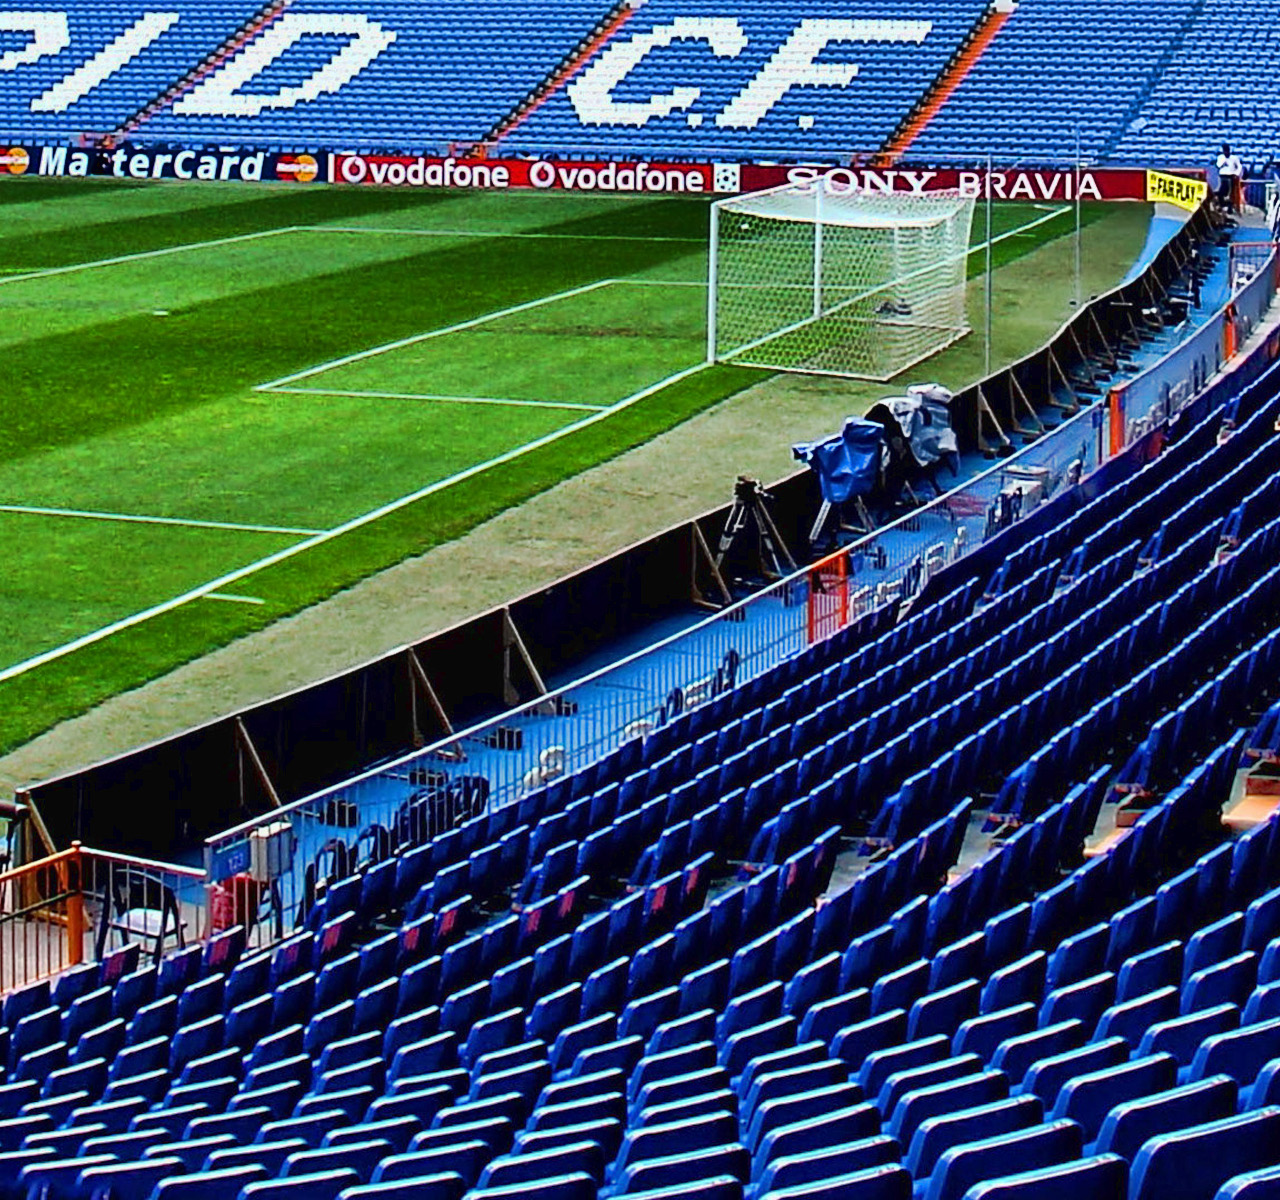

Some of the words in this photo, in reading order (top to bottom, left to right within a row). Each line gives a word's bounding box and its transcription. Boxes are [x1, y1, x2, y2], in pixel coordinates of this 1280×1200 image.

[39, 146, 264, 181] MaterCard
[786, 169, 937, 196] SONY
[959, 172, 1102, 200] BRAVIA
